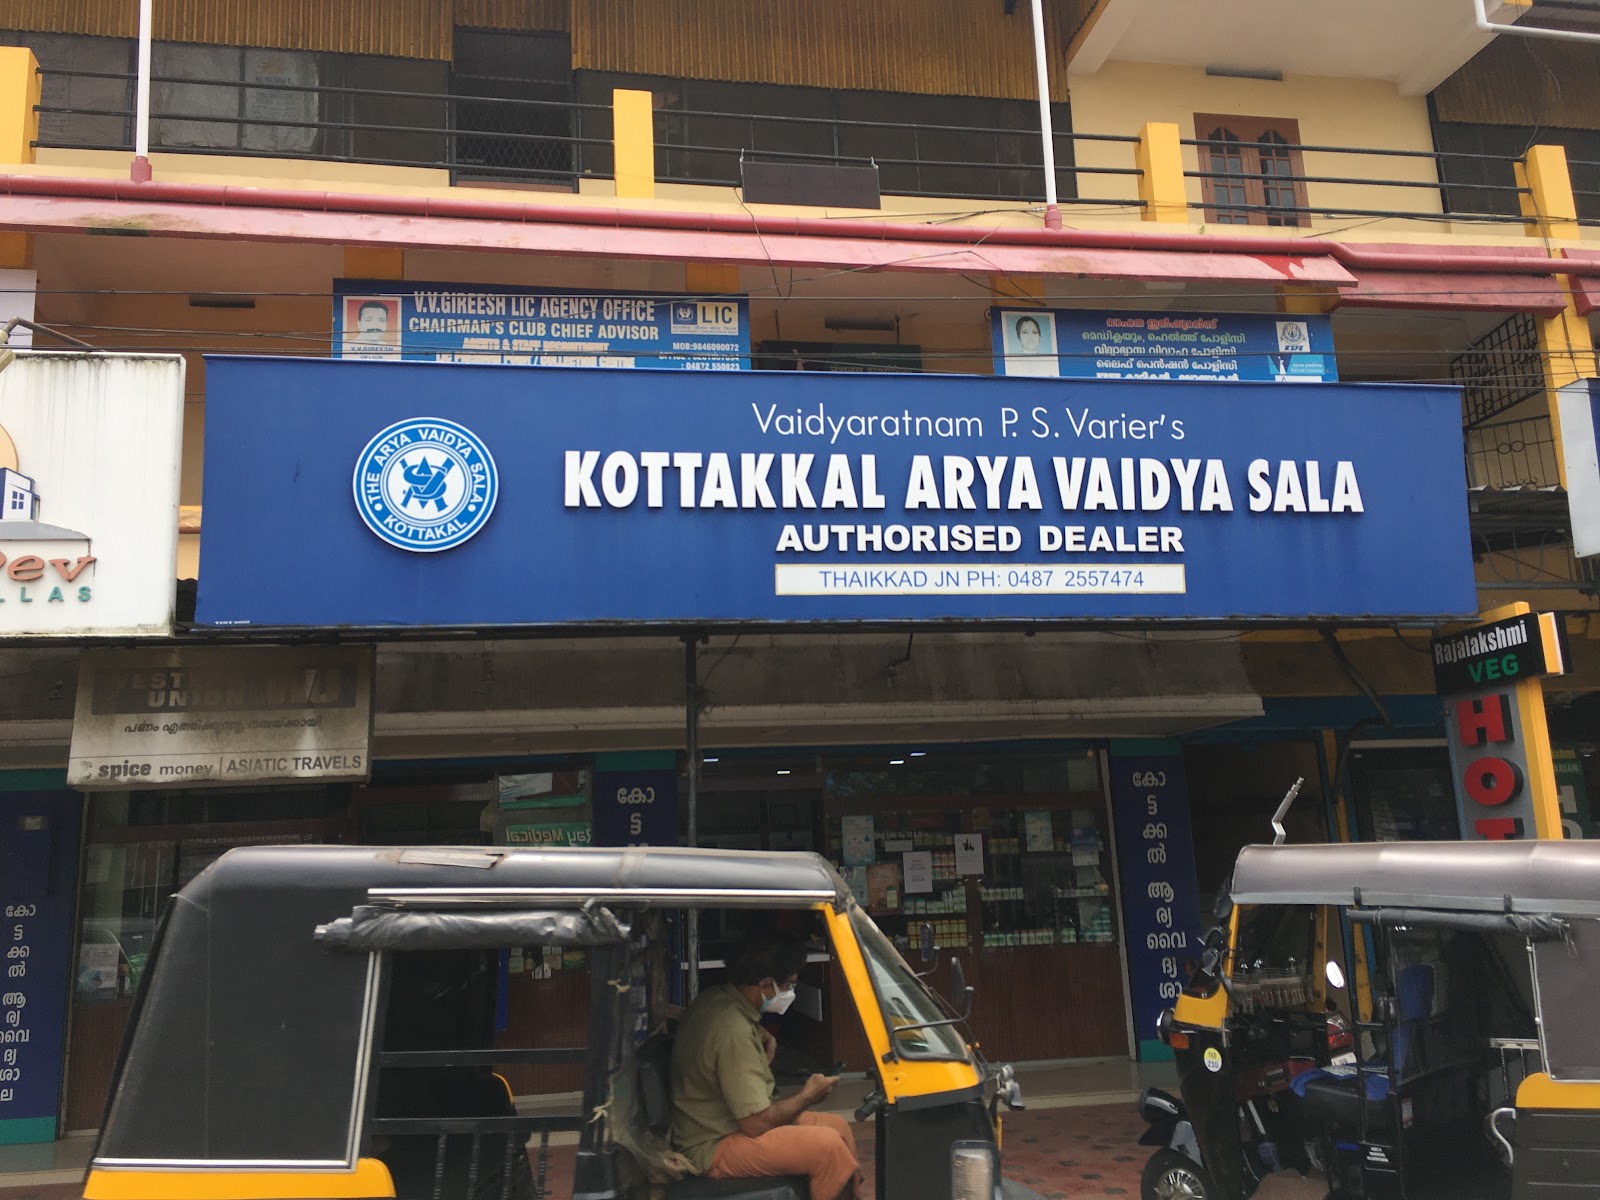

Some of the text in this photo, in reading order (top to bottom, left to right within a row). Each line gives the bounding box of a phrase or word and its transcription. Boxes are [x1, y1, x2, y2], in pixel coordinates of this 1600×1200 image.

[413, 291, 655, 321] V.V.GIREESH LIC AGENCY OFFICE
[702, 305, 733, 324] LIC
[409, 317, 504, 335] CHAIRMAN'S
[509, 321, 546, 336] CLUB
[551, 322, 593, 339] CHIEF
[597, 324, 659, 340] ADVISOR
[1201, 332, 1246, 344] പോളിസി
[1192, 359, 1238, 372] പോളിസി
[751, 402, 983, 445] Vaidyaratnam
[1065, 408, 1186, 440] Varier's
[366, 428, 486, 505] THE ARYA VAIDYA SALA
[564, 450, 1366, 514] KOTTAKKAL ARYA VAIDYA SALA
[383, 514, 468, 541] KOTTAKAL
[775, 524, 1186, 554] AUTHORISED DEALER
[818, 569, 1146, 589] THAIKKAD JN PH: 0487 2557474
[0, 586, 92, 603] LAS
[1433, 619, 1529, 666] Rajalakshmi
[1468, 653, 1520, 684] VEG
[98, 759, 214, 779] spice money
[226, 755, 362, 774] ASIATIC TRAVELS
